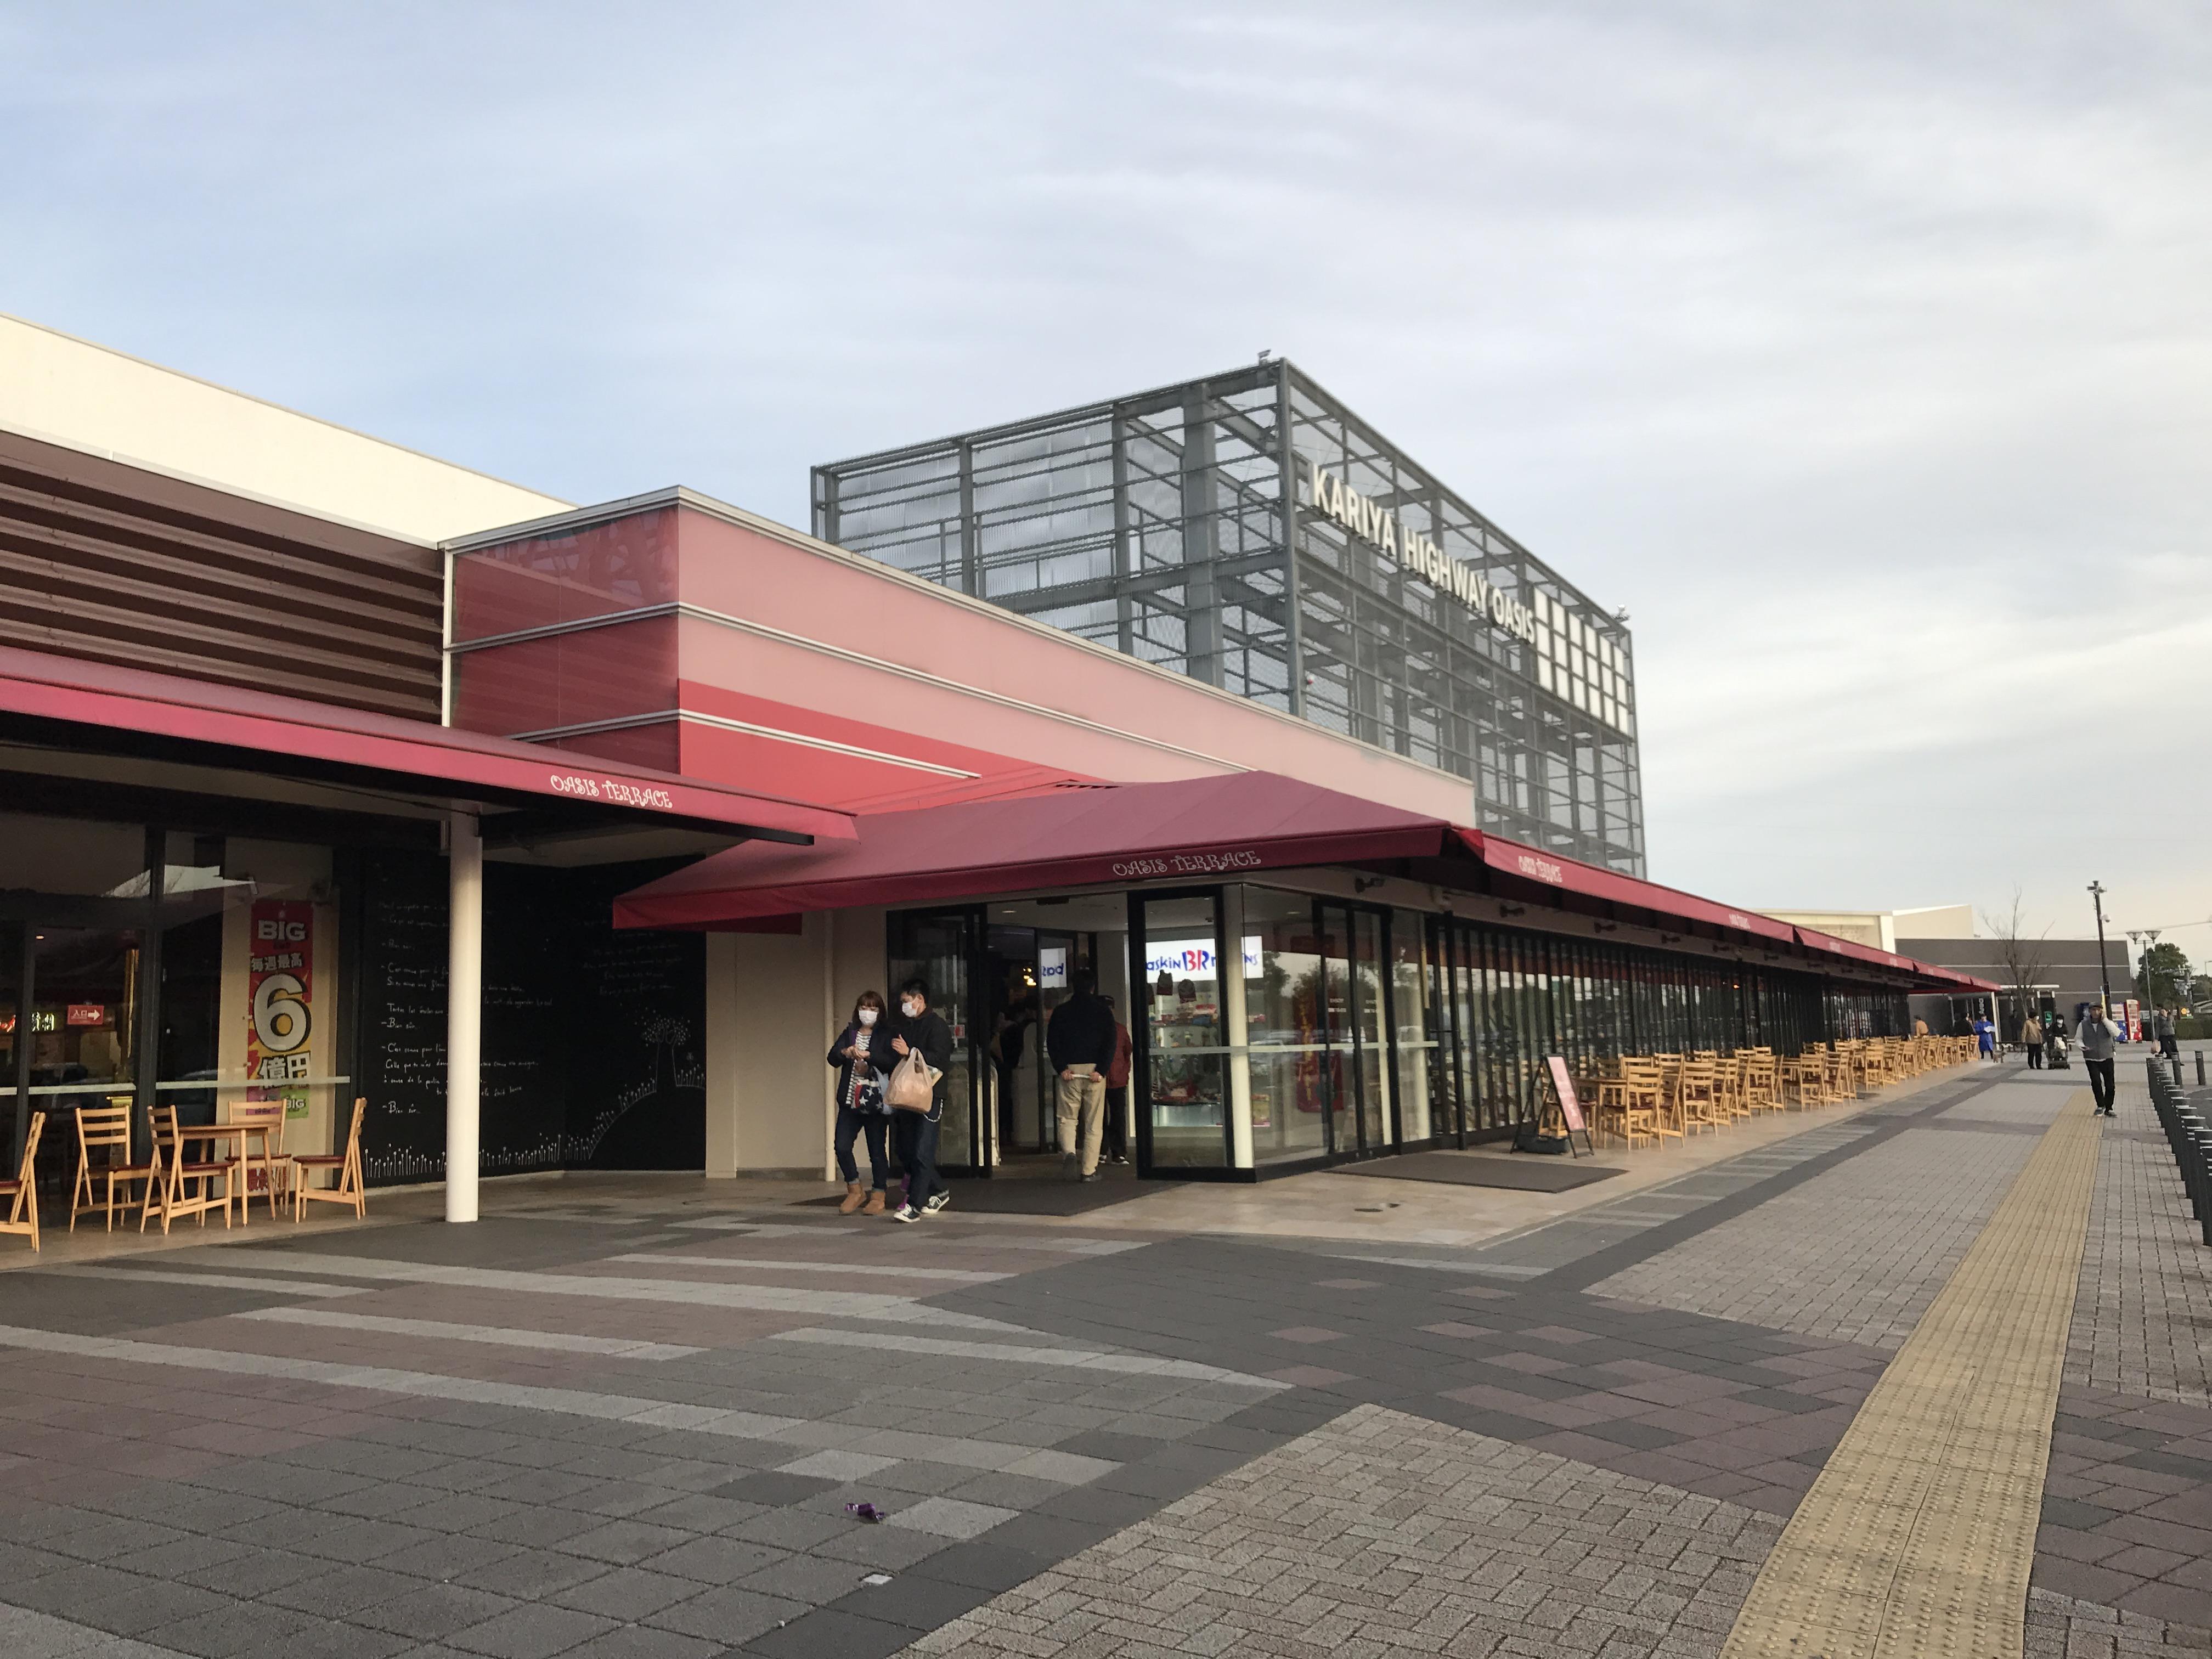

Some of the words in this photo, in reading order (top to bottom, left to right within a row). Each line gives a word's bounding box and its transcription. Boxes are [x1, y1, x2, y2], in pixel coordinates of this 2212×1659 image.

[1310, 462, 1396, 556] KARIYA
[1403, 526, 1487, 616] HIGHWAY
[1492, 588, 1534, 644] OASIS
[550, 775, 600, 797] OASIS
[602, 780, 673, 808] TERRACE
[1113, 859, 1167, 876] OASIS
[1170, 850, 1261, 871] TERRACE
[258, 919, 306, 941] BIG
[1146, 956, 1181, 970] askin
[253, 973, 311, 1052] 6
